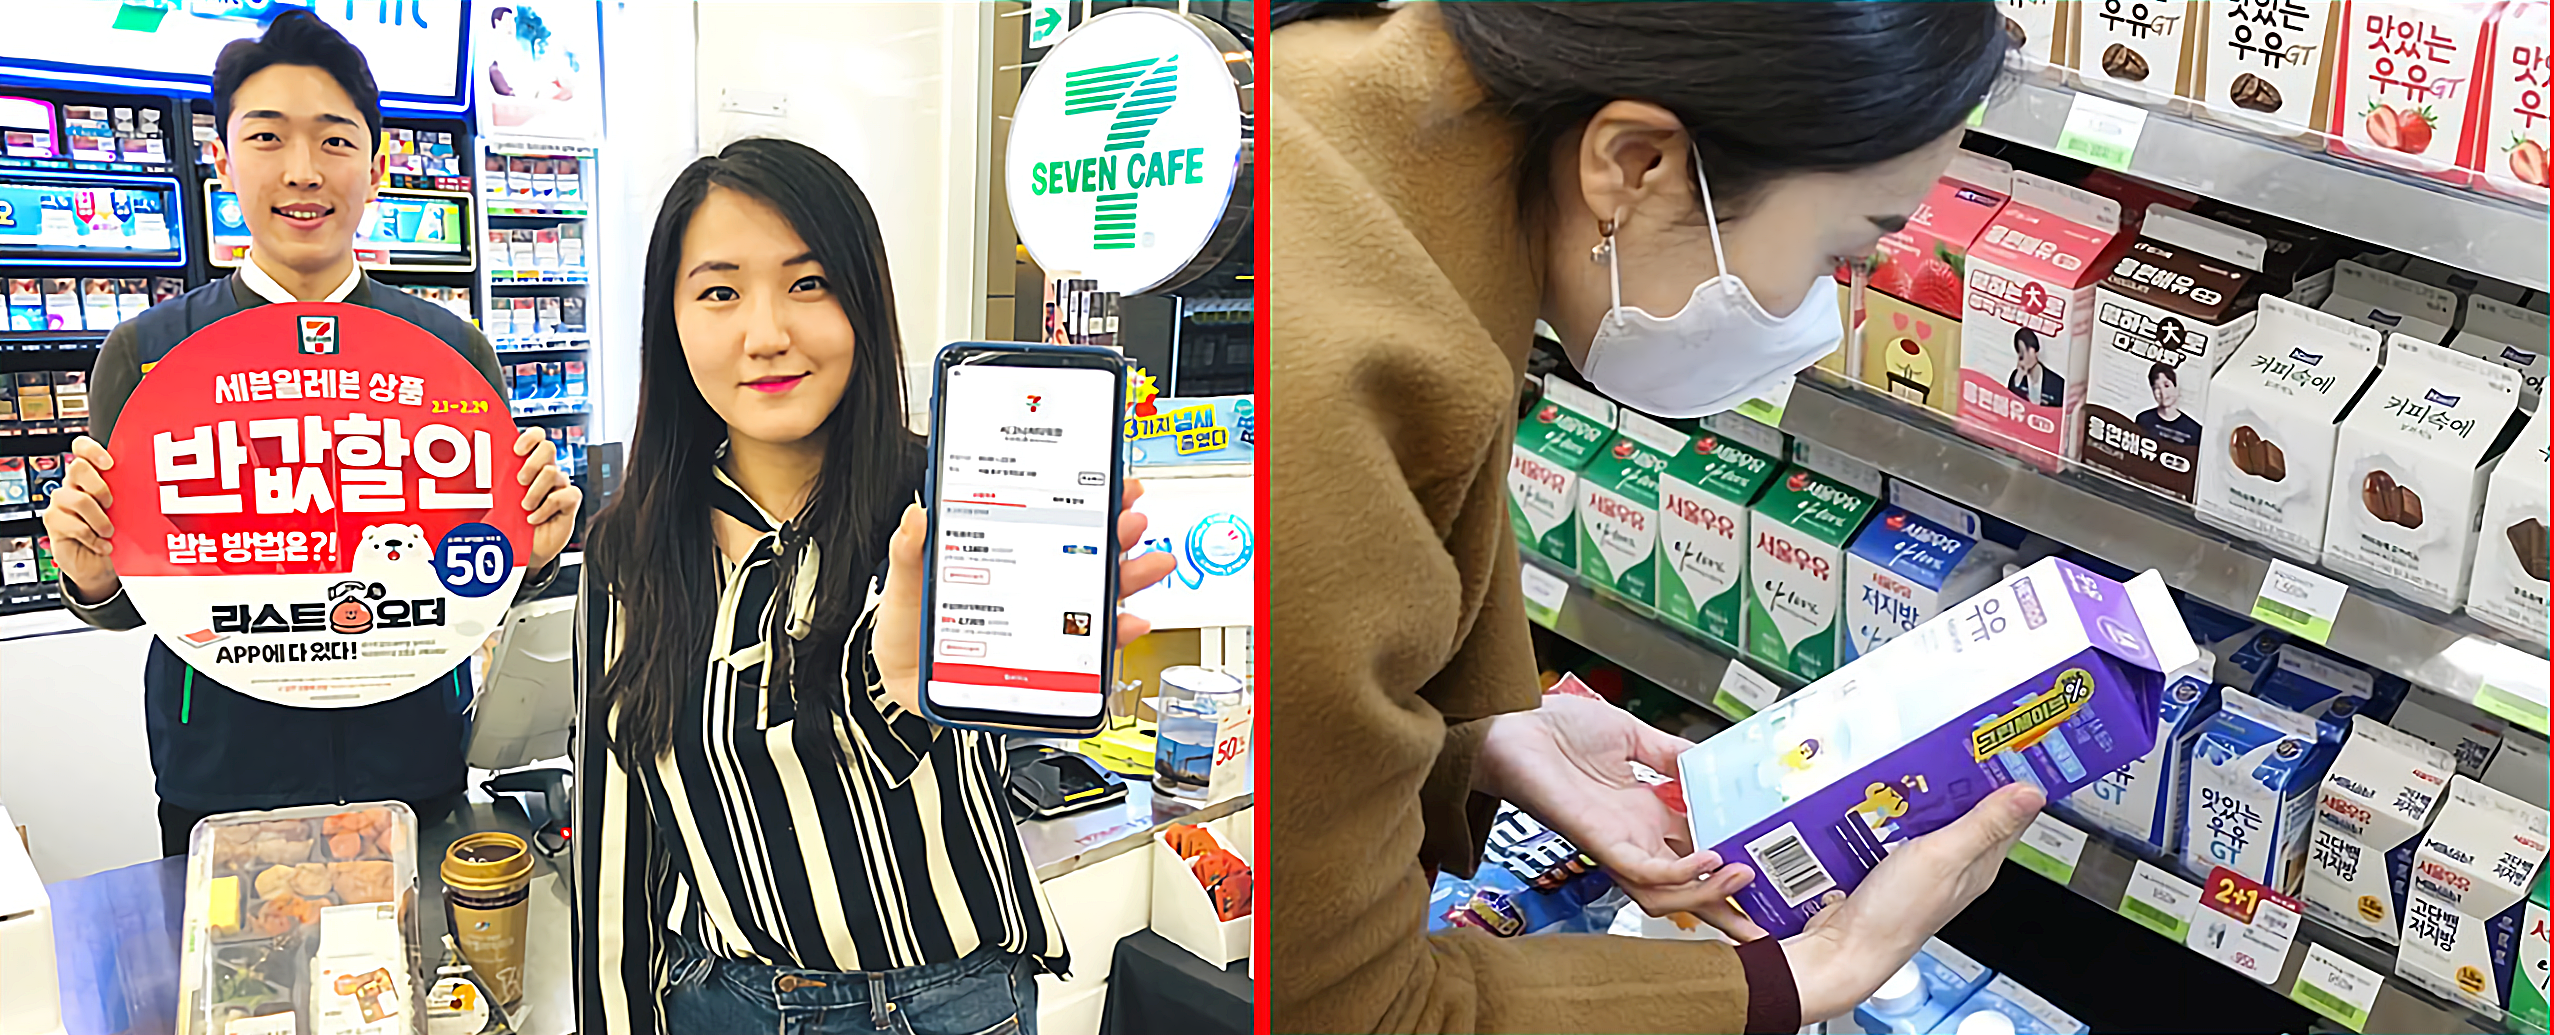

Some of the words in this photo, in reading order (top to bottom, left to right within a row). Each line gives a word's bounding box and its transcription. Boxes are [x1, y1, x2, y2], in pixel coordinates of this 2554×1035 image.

[2367, 15, 2457, 64] 맛있는
[2514, 90, 2550, 128] 우
[1032, 155, 1117, 196] SEVEN
[1127, 147, 1204, 189] CAFE
[215, 369, 360, 404] 세븐일레븐
[368, 374, 424, 406] 상품
[2251, 355, 2335, 395] 커피속에
[2384, 396, 2475, 438] 커피속에
[153, 412, 494, 515] 반값할인
[167, 532, 219, 565] 받는
[221, 531, 337, 564] 방법은?!
[446, 545, 504, 586] 50
[212, 602, 326, 635] 라스트
[376, 598, 445, 629] 오더
[1861, 584, 1920, 632] 저지방
[1965, 598, 2006, 642] 우유
[215, 643, 284, 664] APP에
[2093, 782, 2127, 806] GT
[2206, 815, 2249, 849] 우유
[2314, 829, 2362, 862] 고단백
[2210, 840, 2242, 865] GT
[2312, 848, 2358, 882] 저지방
[2214, 878, 2259, 914] 2+1
[2410, 897, 2460, 931] 고단백
[2408, 916, 2457, 952] 저지방
